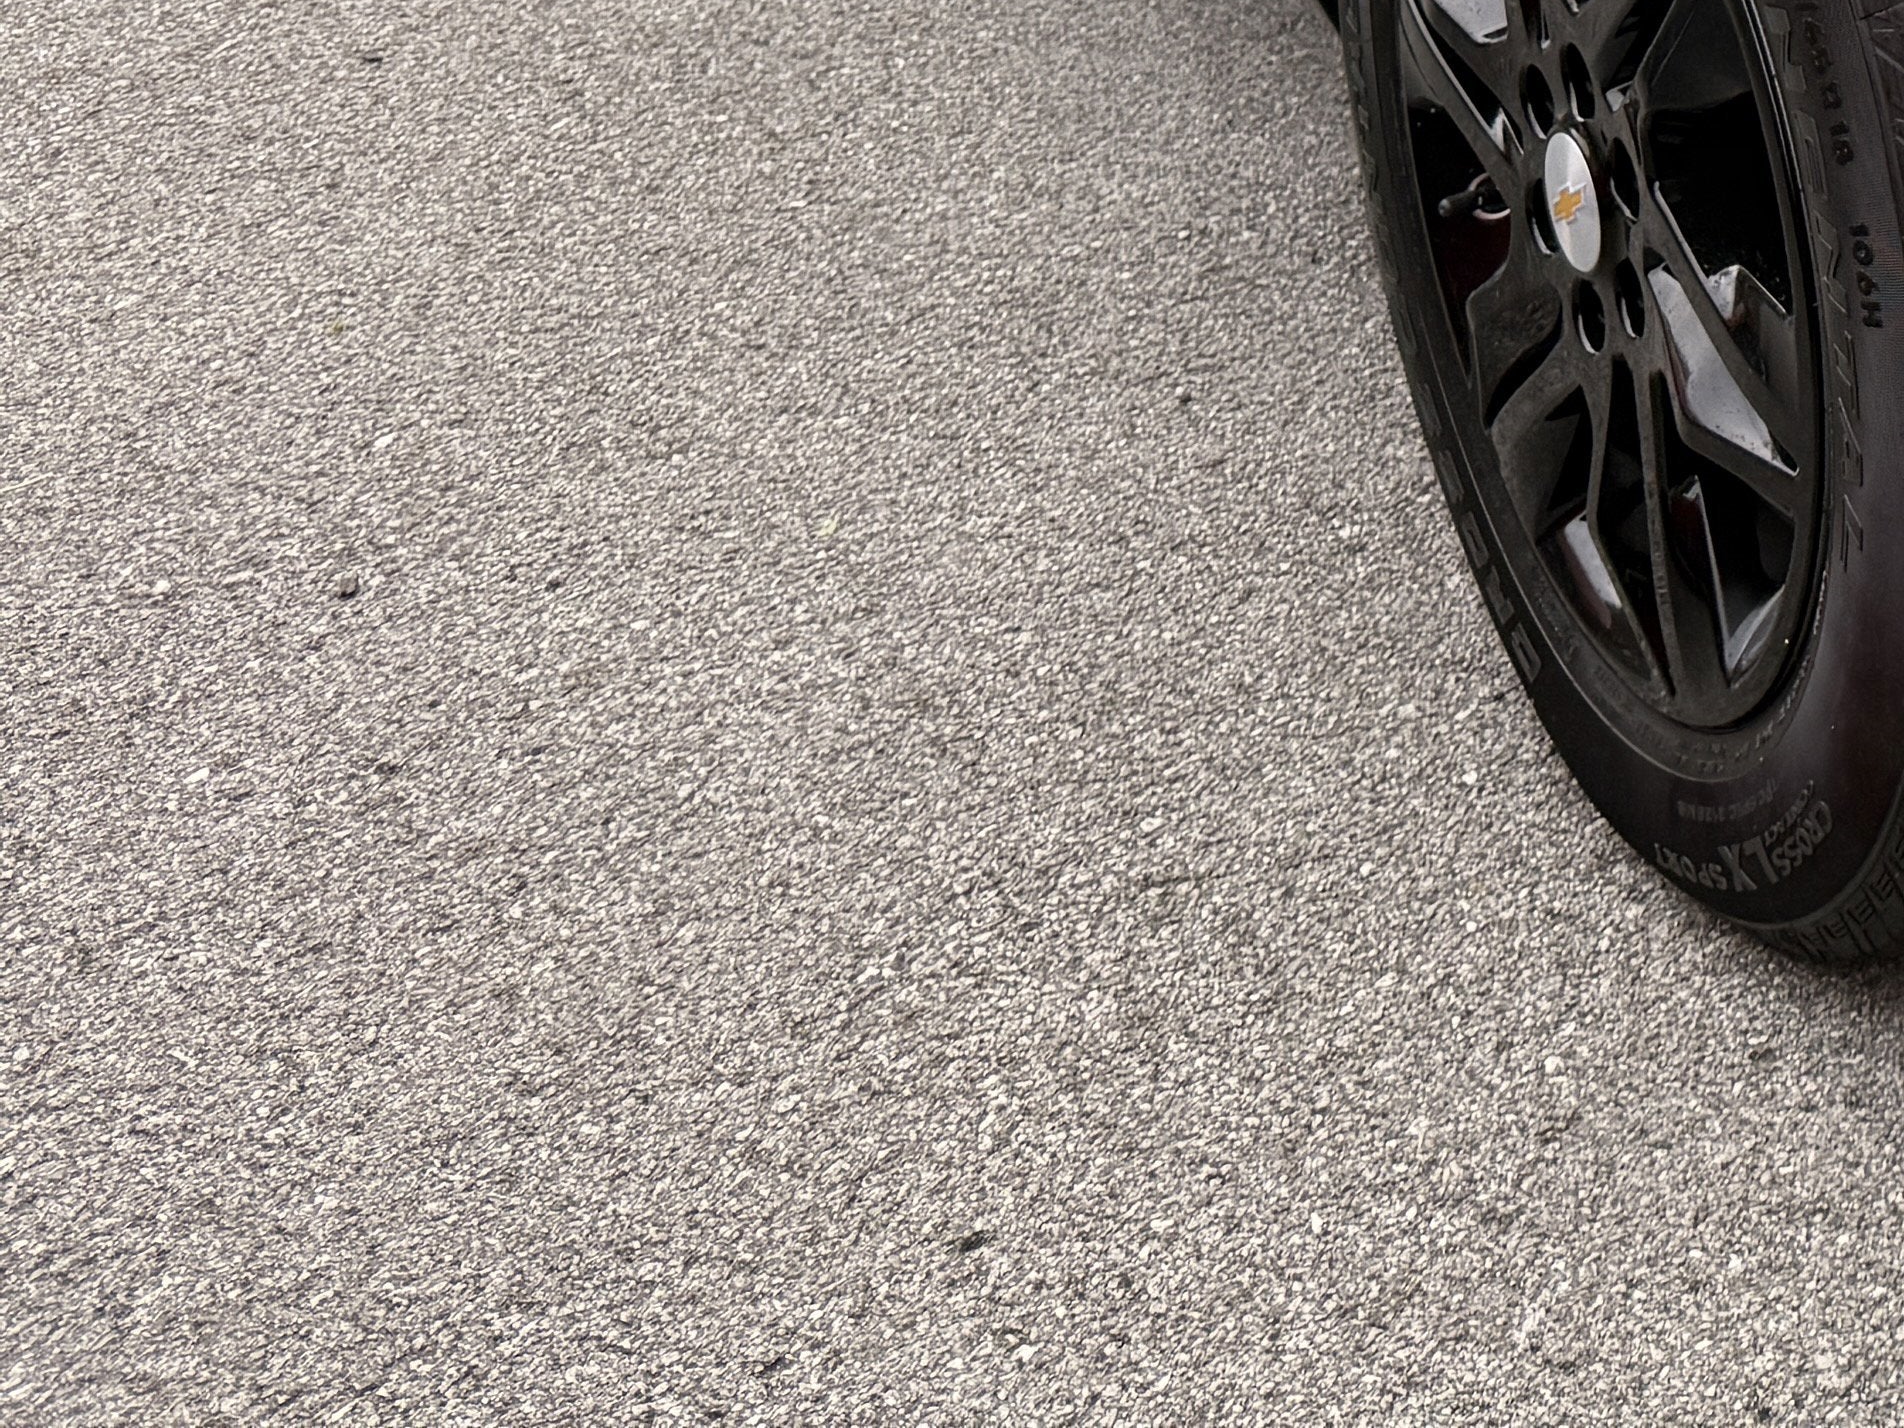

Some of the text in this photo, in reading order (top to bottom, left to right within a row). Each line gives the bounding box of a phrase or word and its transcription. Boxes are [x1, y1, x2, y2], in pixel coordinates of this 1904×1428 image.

[1653, 799, 1834, 893] CROSS LX SPORT
